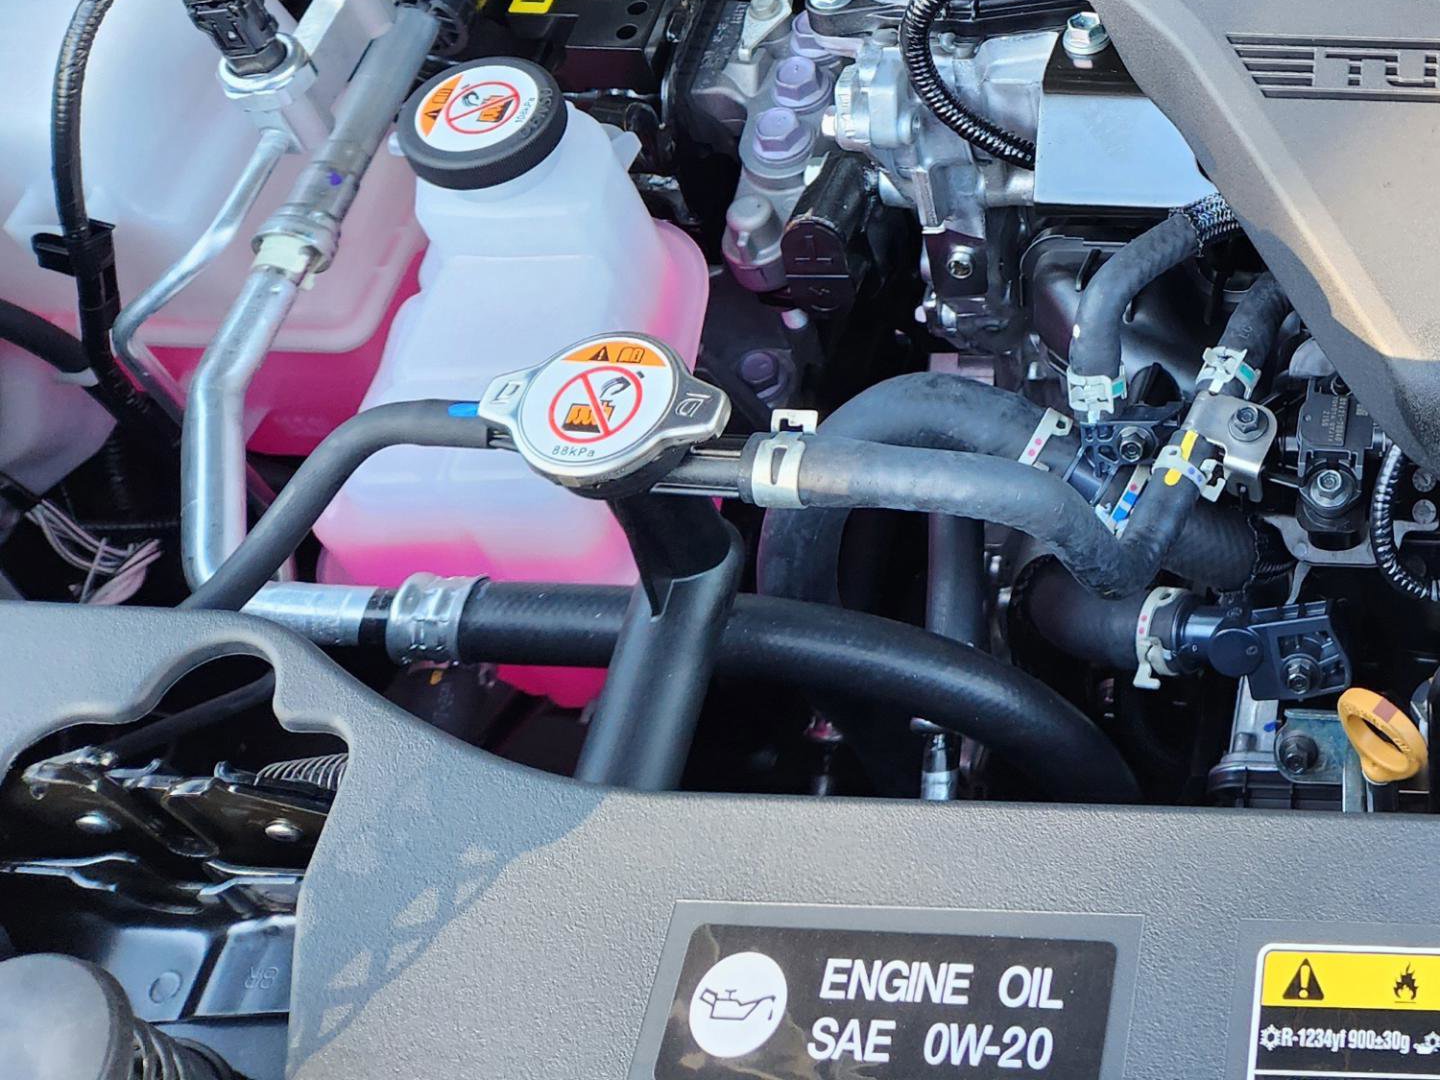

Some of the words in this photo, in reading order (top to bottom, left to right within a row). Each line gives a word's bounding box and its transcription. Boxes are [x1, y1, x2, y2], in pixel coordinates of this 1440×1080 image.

[551, 444, 596, 458] 88kPa
[819, 957, 974, 1005] ENGINE
[998, 965, 1064, 1011] OIL
[806, 1016, 897, 1063] SAE
[923, 1022, 1055, 1070] 0W-20
[1280, 1025, 1347, 1051] R-1234yf
